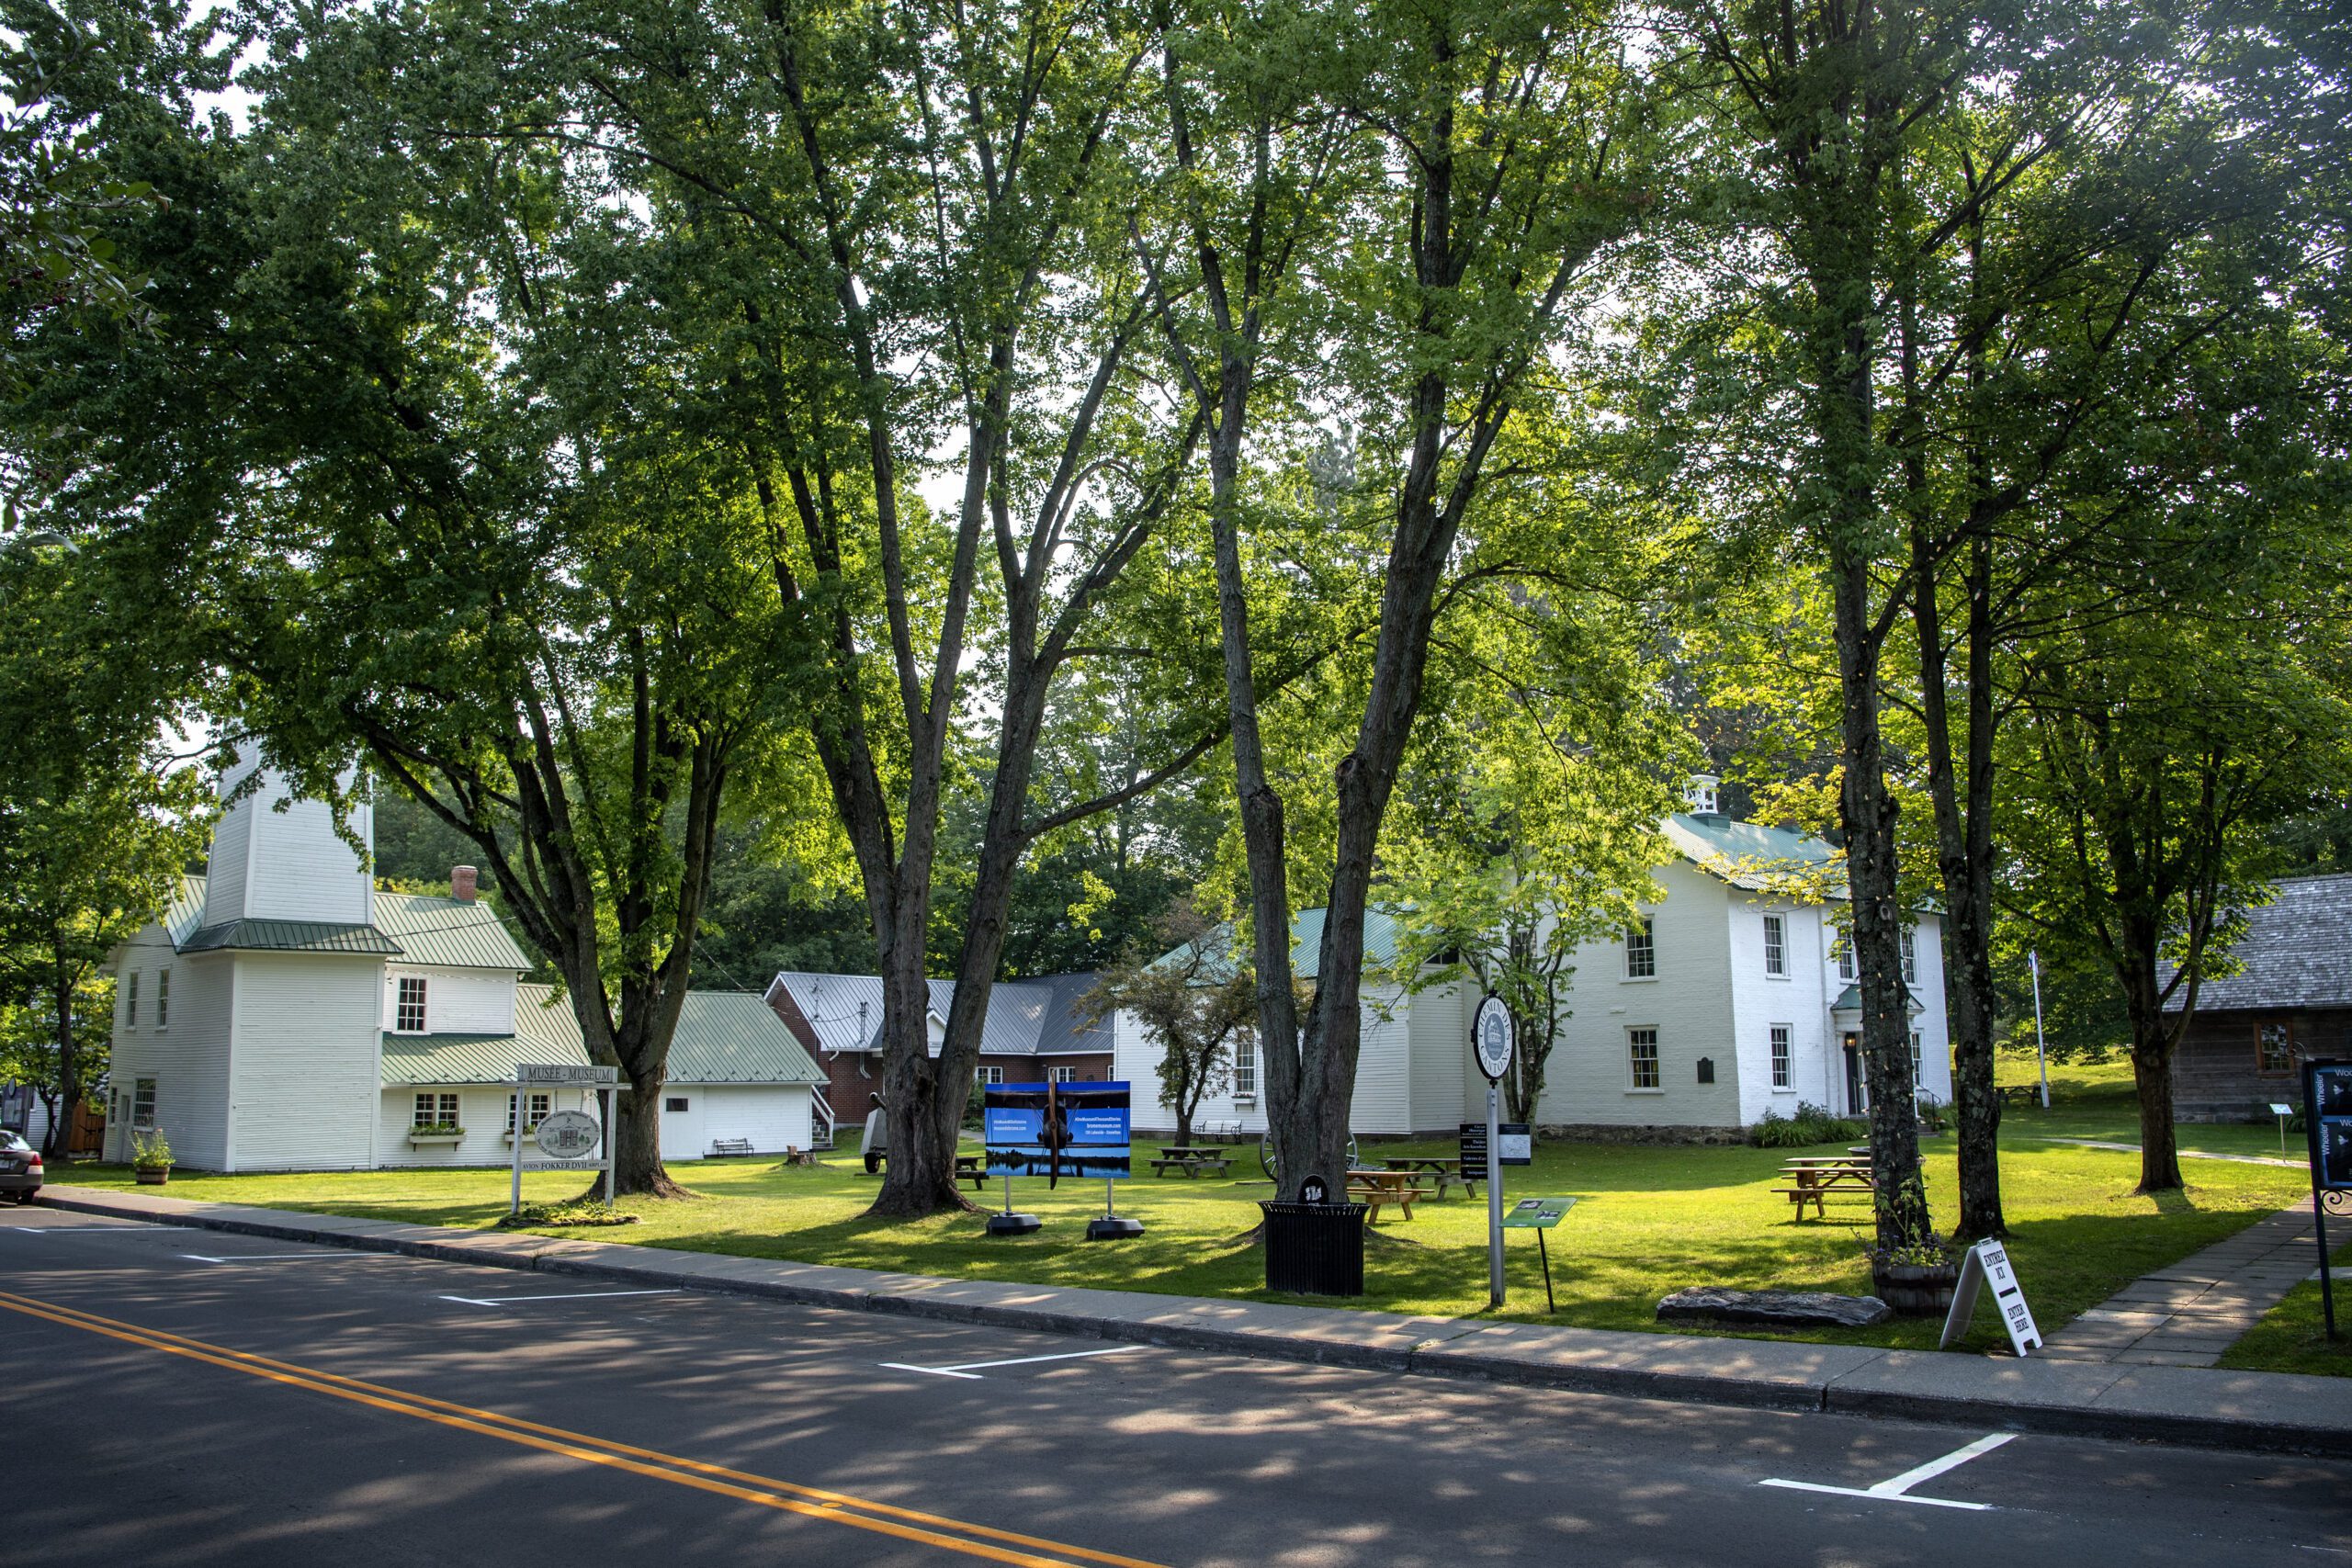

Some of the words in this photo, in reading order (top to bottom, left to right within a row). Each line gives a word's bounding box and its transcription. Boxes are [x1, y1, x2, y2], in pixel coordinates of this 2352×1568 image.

[1479, 1001, 1501, 1038] CHEMIN
[1502, 1012, 1511, 1041] DES
[1480, 1045, 1510, 1074] CANTONS
[527, 1066, 560, 1079] MUSÉE
[569, 1066, 610, 1081] MUSEUM
[2315, 1074, 2325, 1105] Wheeler
[2320, 1123, 2330, 1155] Wheeler
[541, 1162, 570, 1170] FOKKER
[571, 1161, 587, 1169] DVII
[1984, 1250, 2006, 1268] ENTREZ
[2007, 1303, 2025, 1320] ENTER
[2014, 1317, 2030, 1333] HERE
